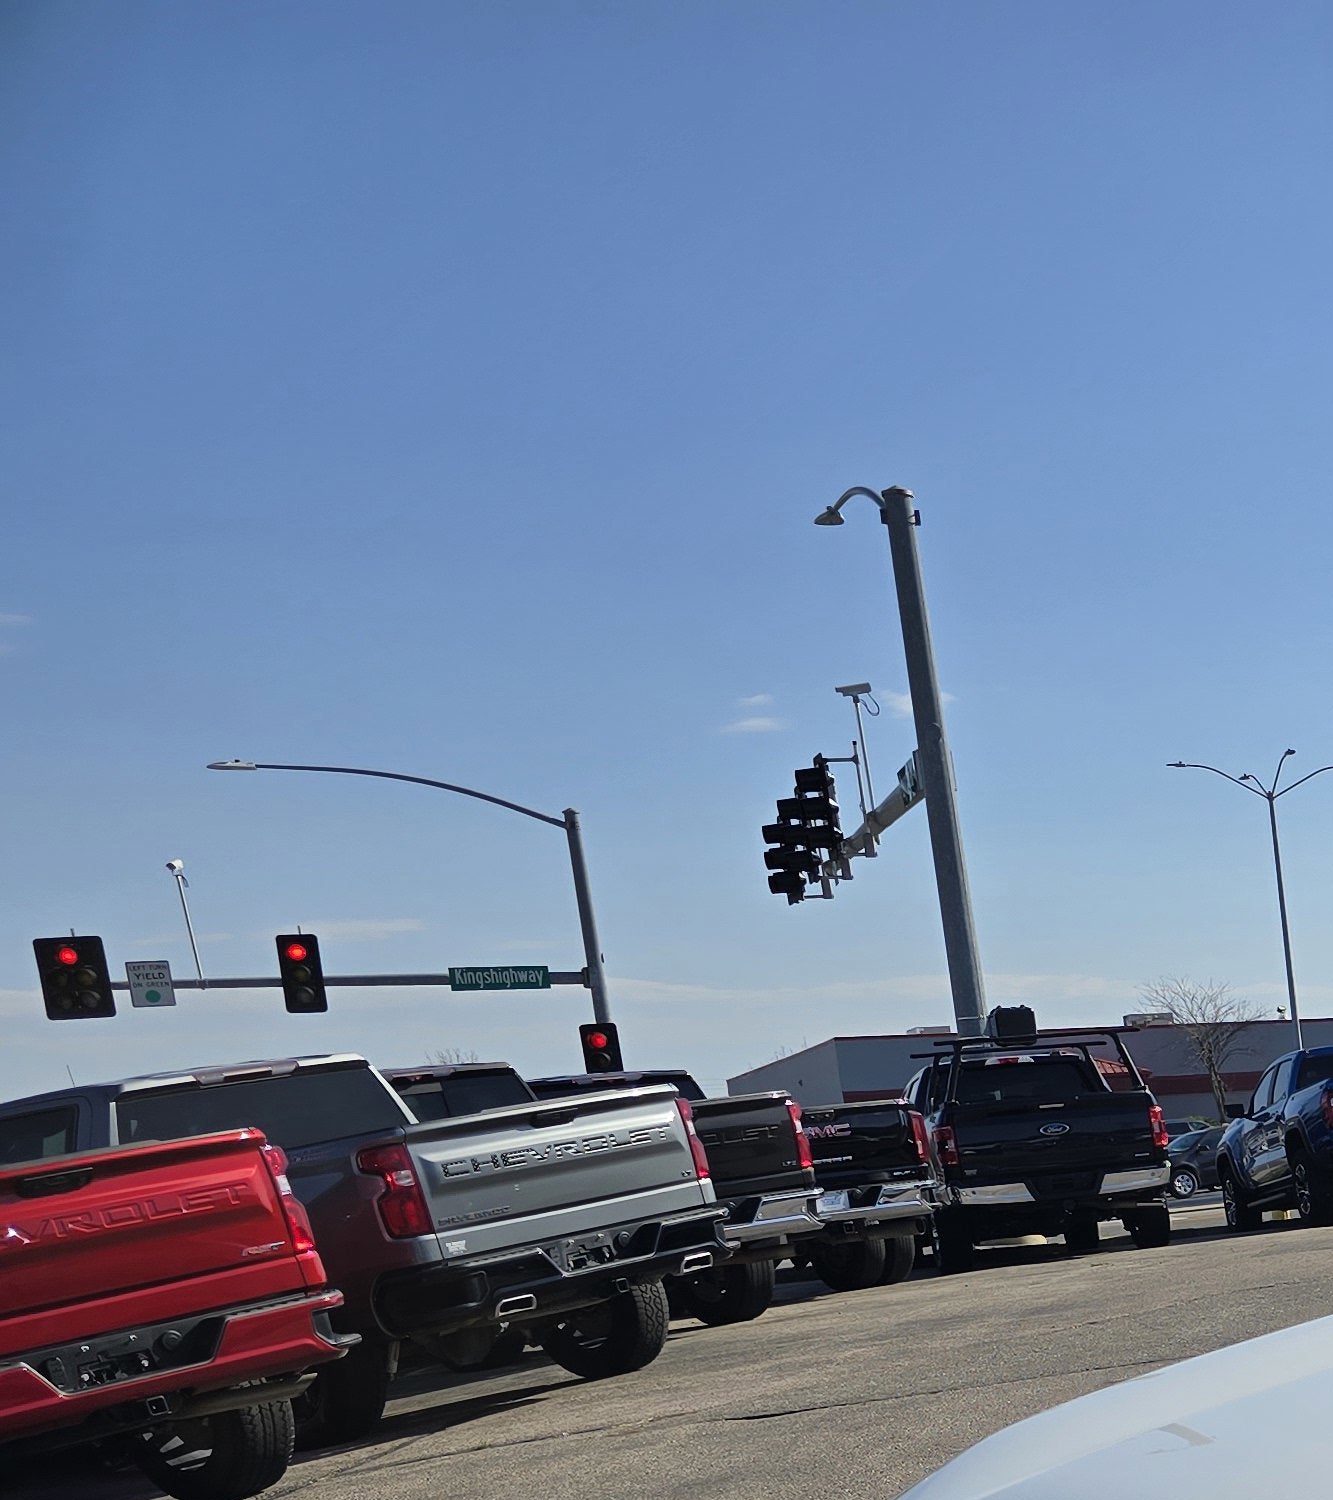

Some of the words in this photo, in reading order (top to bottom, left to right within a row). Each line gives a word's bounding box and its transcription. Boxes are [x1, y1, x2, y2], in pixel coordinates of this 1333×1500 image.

[134, 972, 165, 980] YIELD
[453, 967, 544, 989] Kingshighway
[441, 1122, 672, 1179] CHEVROLET
